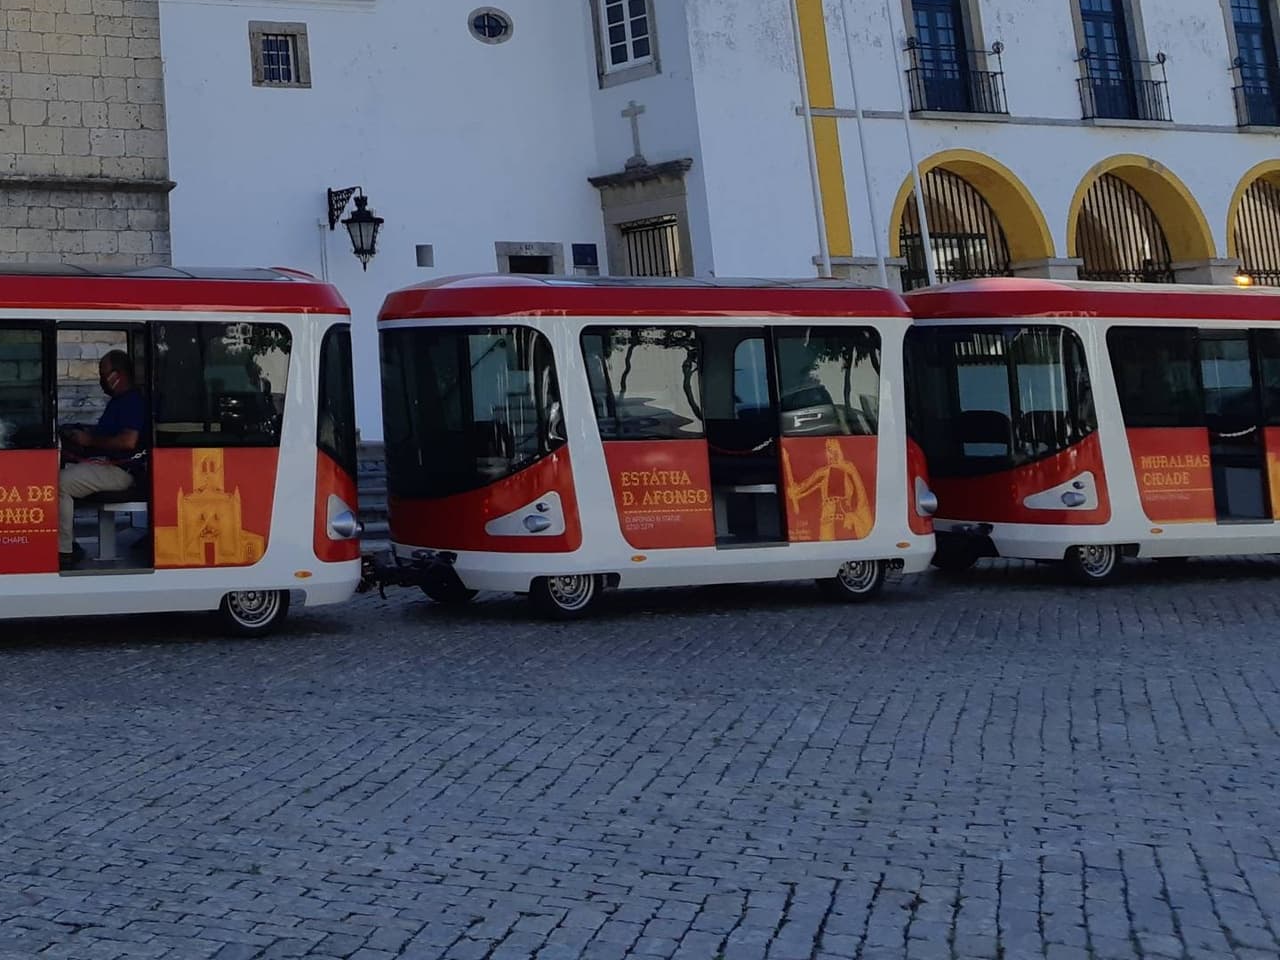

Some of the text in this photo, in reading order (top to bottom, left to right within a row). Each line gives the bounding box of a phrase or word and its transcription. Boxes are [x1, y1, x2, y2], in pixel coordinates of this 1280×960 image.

[1141, 455, 1210, 469] MURALHAS
[621, 467, 691, 487] ESTÁTUA
[1143, 472, 1190, 486] CIDADE
[27, 485, 55, 501] DE
[623, 489, 708, 506] D. AFONSO
